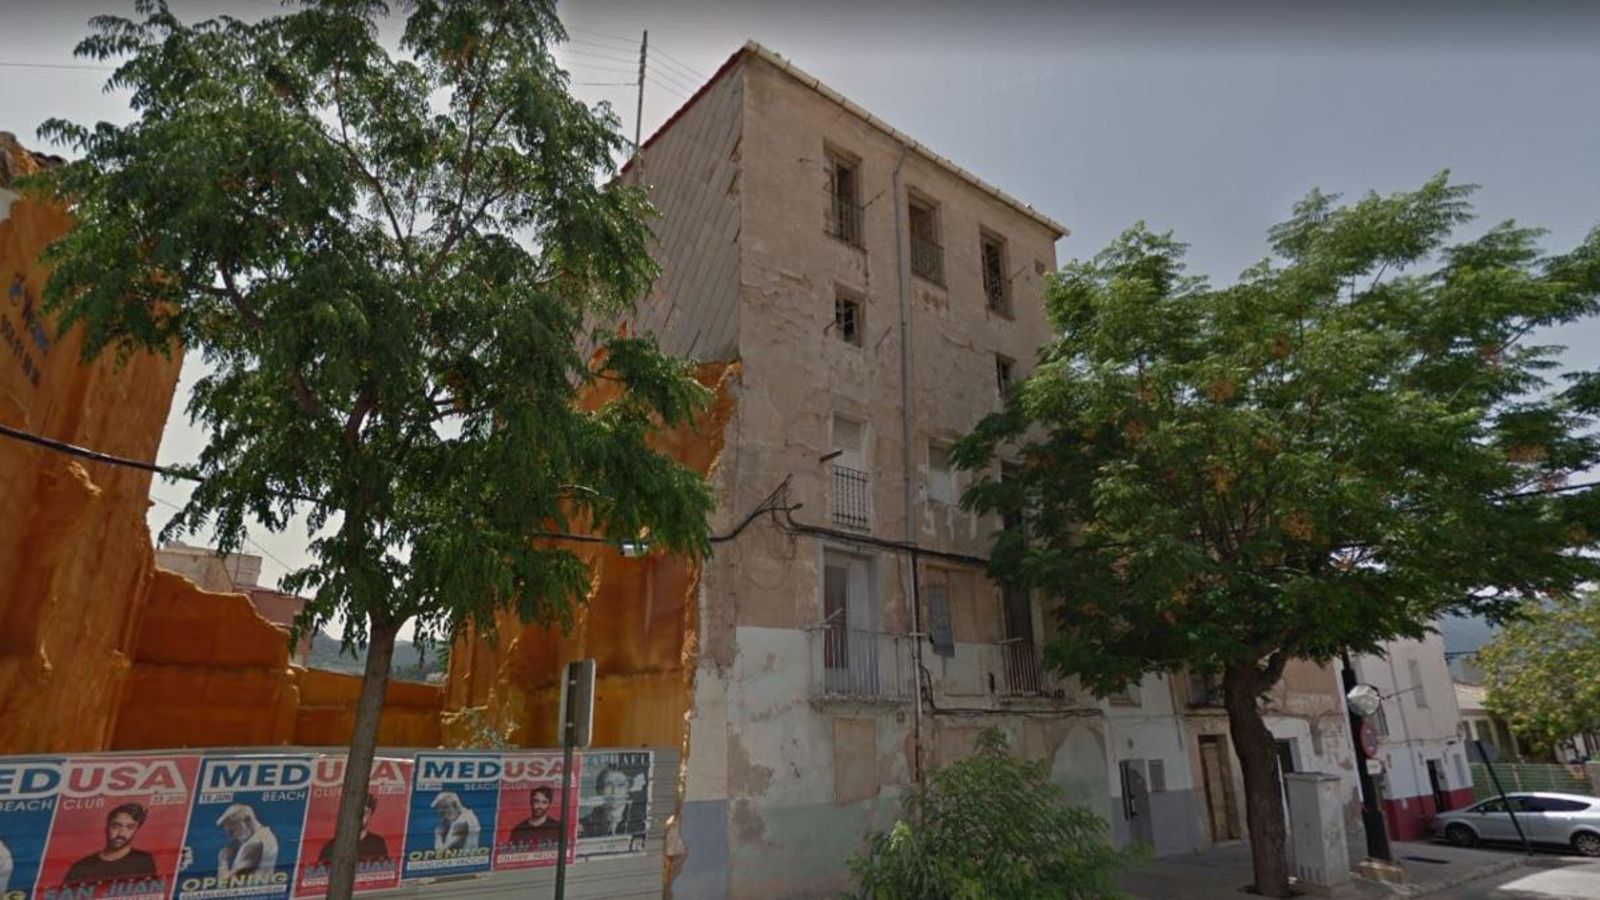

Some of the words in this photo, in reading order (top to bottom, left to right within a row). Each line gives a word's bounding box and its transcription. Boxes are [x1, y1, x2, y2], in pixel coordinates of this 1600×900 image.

[210, 761, 398, 788] MEDUA
[262, 790, 305, 801] BEACH
[313, 789, 342, 799] CLU
[63, 799, 105, 810] CLUB
[181, 872, 288, 891] OPENING
